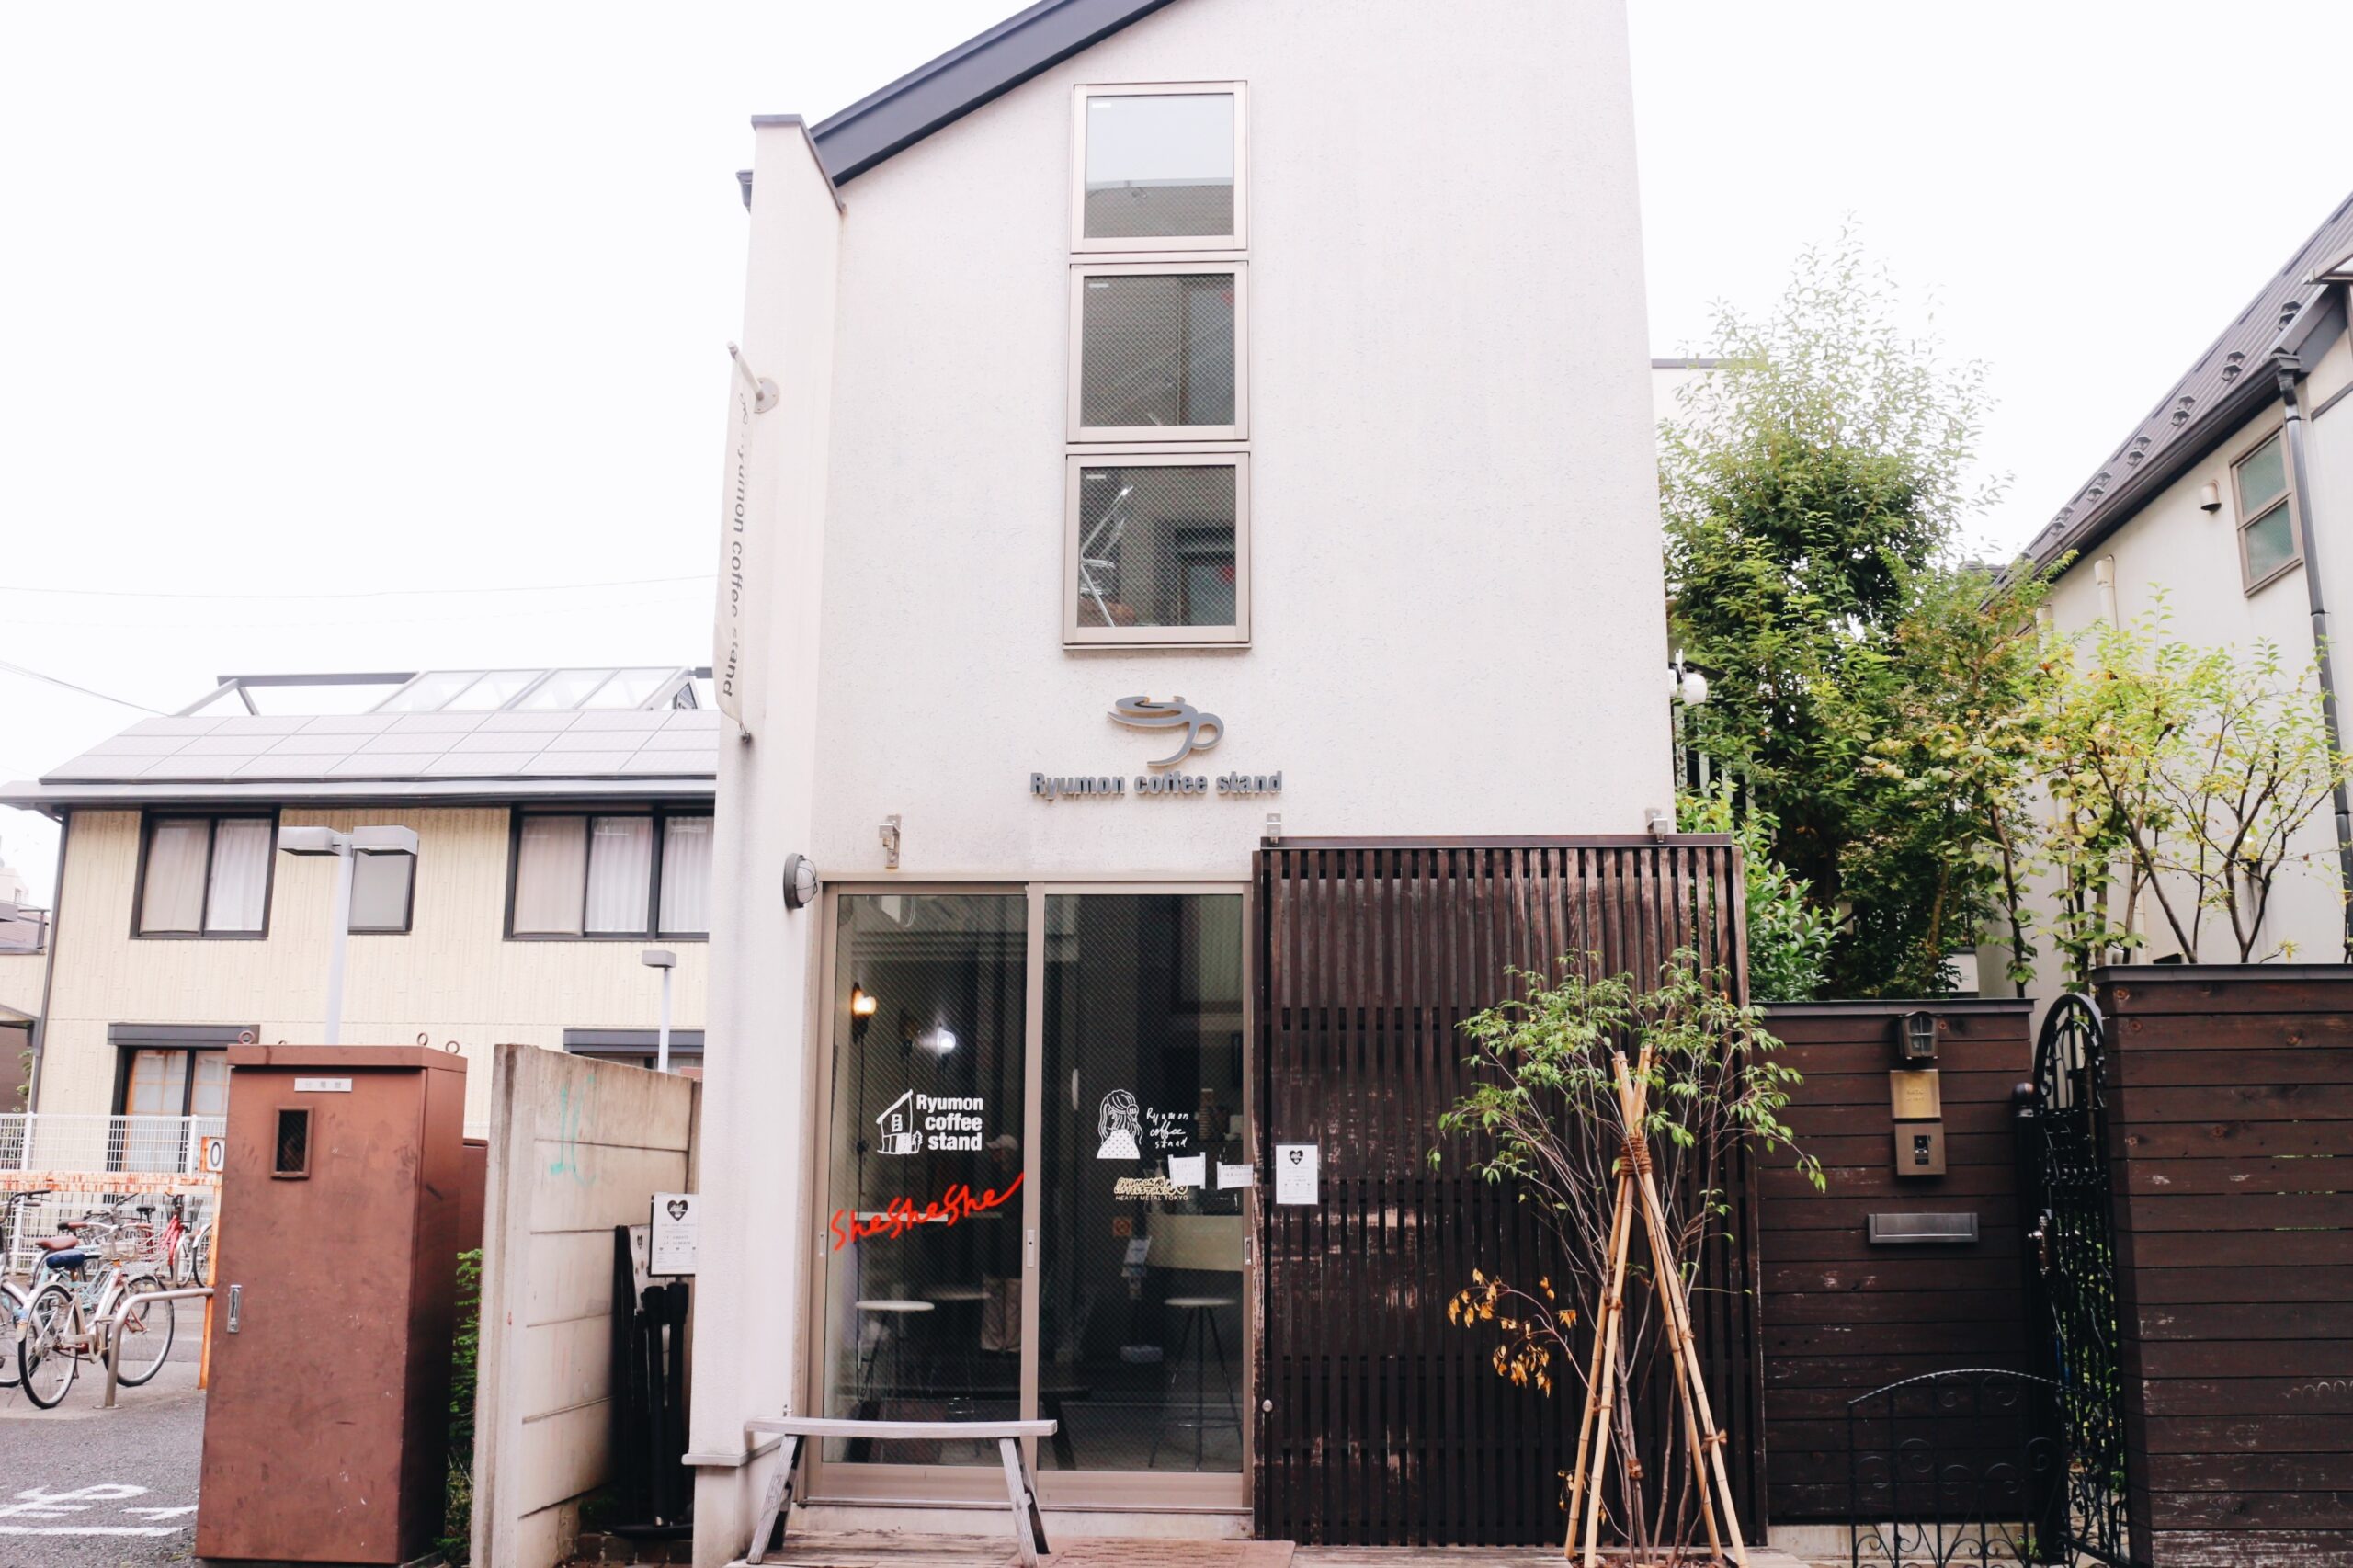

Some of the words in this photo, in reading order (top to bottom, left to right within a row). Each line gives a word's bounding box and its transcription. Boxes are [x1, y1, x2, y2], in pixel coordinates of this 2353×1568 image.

[733, 433, 747, 533] yumon
[730, 540, 743, 618] coffee
[1030, 772, 1126, 800] Ryumon
[1133, 771, 1209, 794] coffee
[1215, 770, 1283, 794] stand
[916, 1094, 983, 1113] Ryumon
[925, 1112, 983, 1131] coffee
[1146, 1107, 1188, 1126] Ryumon
[1150, 1119, 1186, 1140] coffee
[928, 1132, 983, 1151] stand
